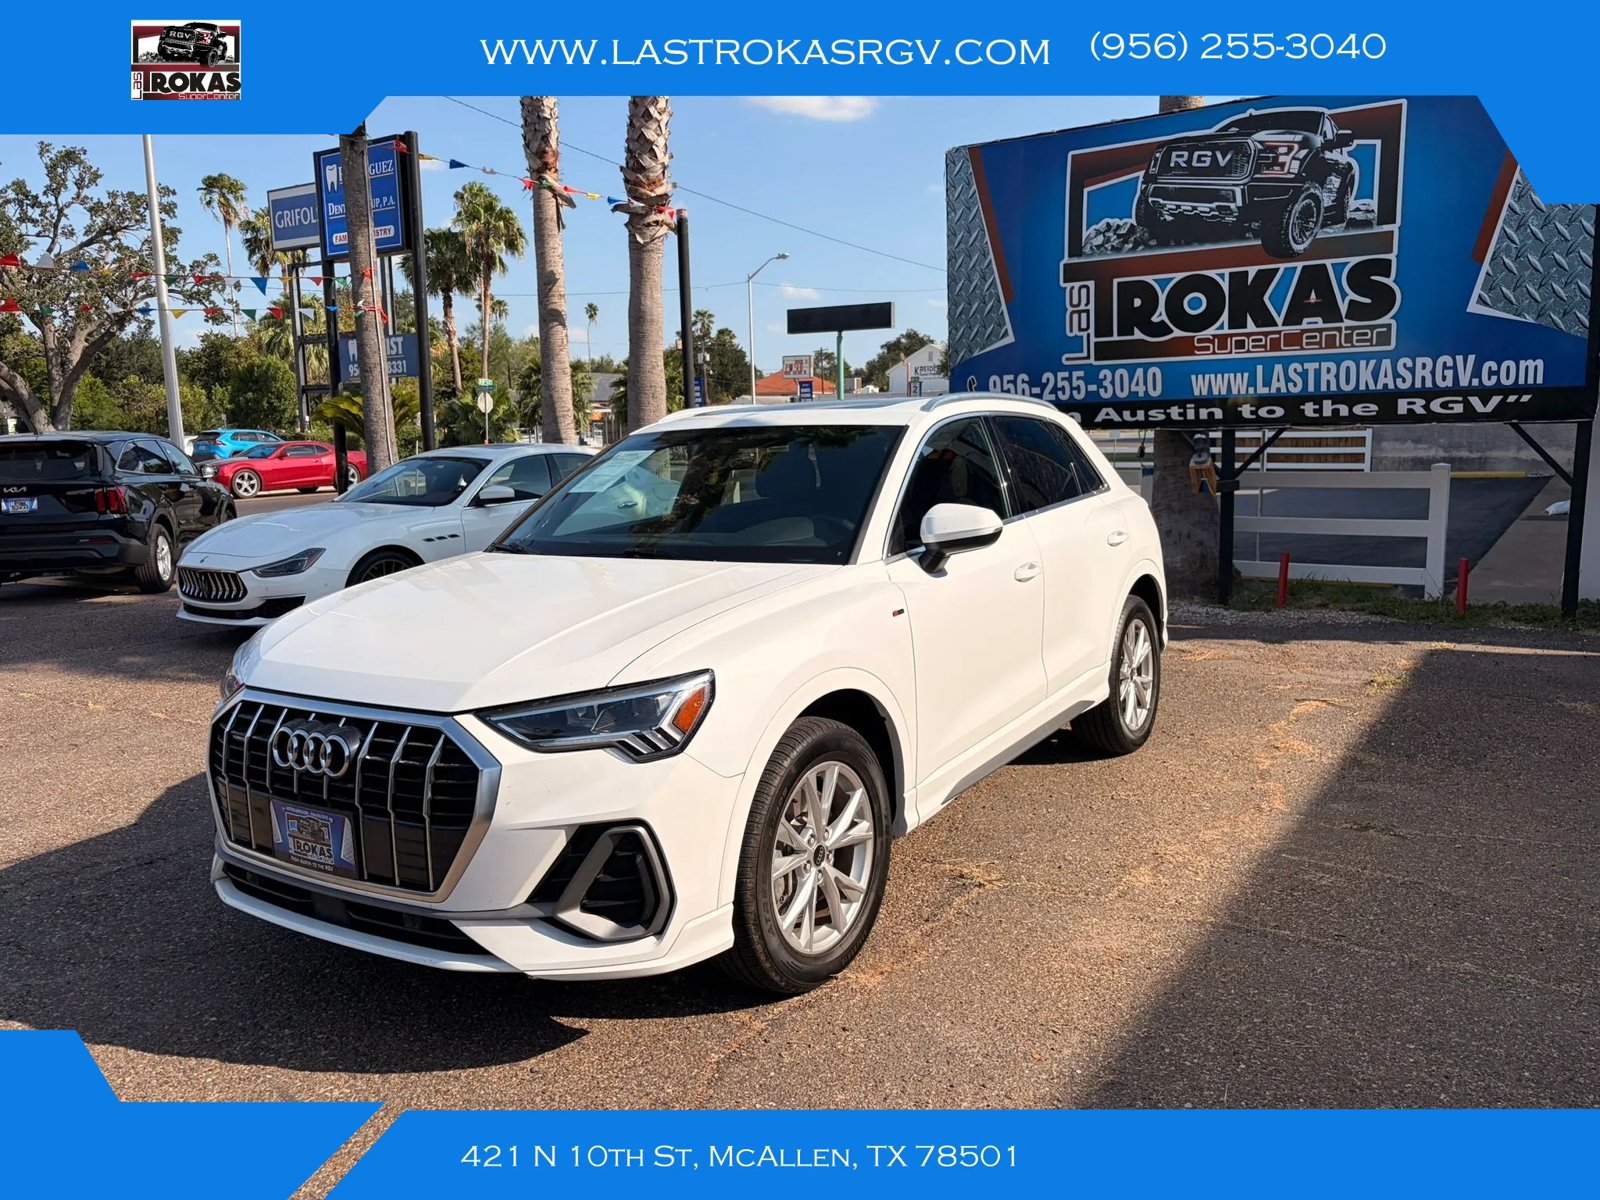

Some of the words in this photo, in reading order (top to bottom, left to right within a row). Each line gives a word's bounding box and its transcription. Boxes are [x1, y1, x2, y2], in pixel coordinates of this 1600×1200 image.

[1169, 150, 1235, 170] RGV
[275, 206, 318, 230] GRIFOL
[1064, 257, 1400, 340] TROKAS
[1193, 327, 1388, 355] SuperCenter
[988, 366, 1163, 400] 956-255-3040
[1190, 354, 1545, 397] www.LASTROKASRGV.com
[1094, 403, 1224, 424] Austin
[1237, 401, 1286, 420] to
[1299, 399, 1380, 418] the
